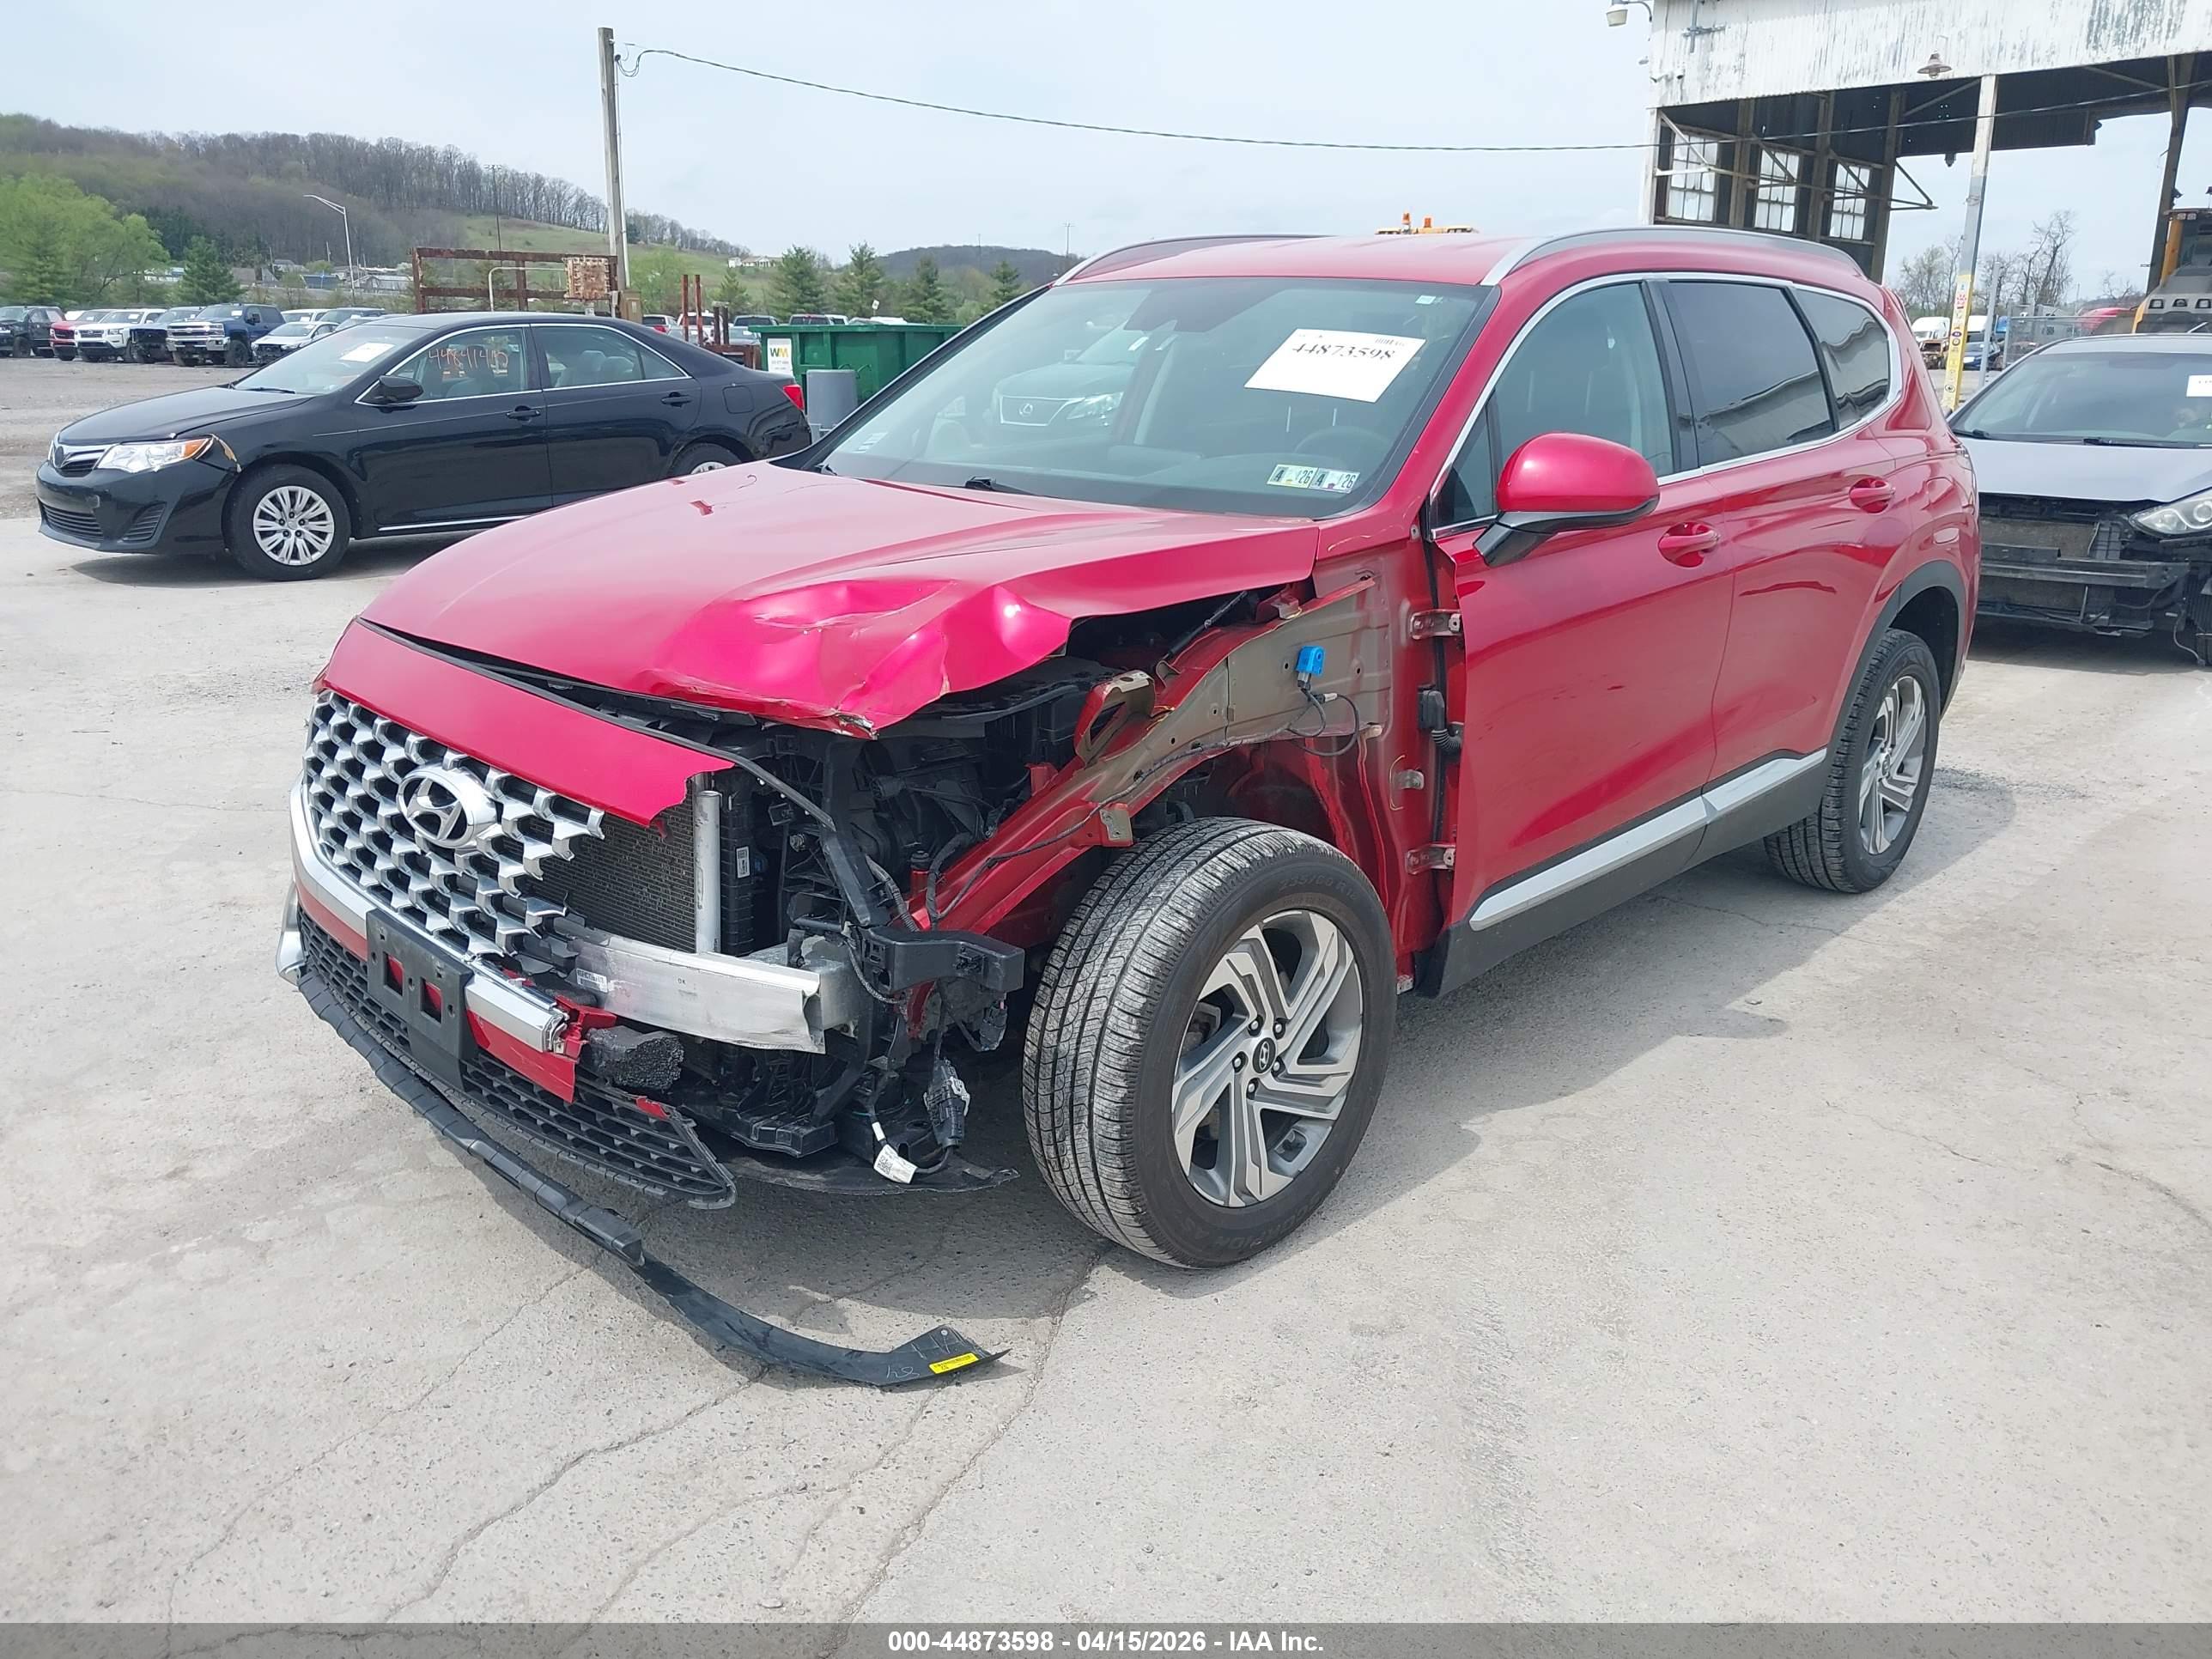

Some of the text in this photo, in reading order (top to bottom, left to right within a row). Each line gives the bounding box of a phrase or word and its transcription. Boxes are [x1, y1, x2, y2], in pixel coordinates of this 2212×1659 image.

[769, 347, 789, 358] WM
[1291, 343, 1396, 361] 44873598
[1274, 469, 1314, 483] 4 26
[1316, 473, 1356, 488] 4 26
